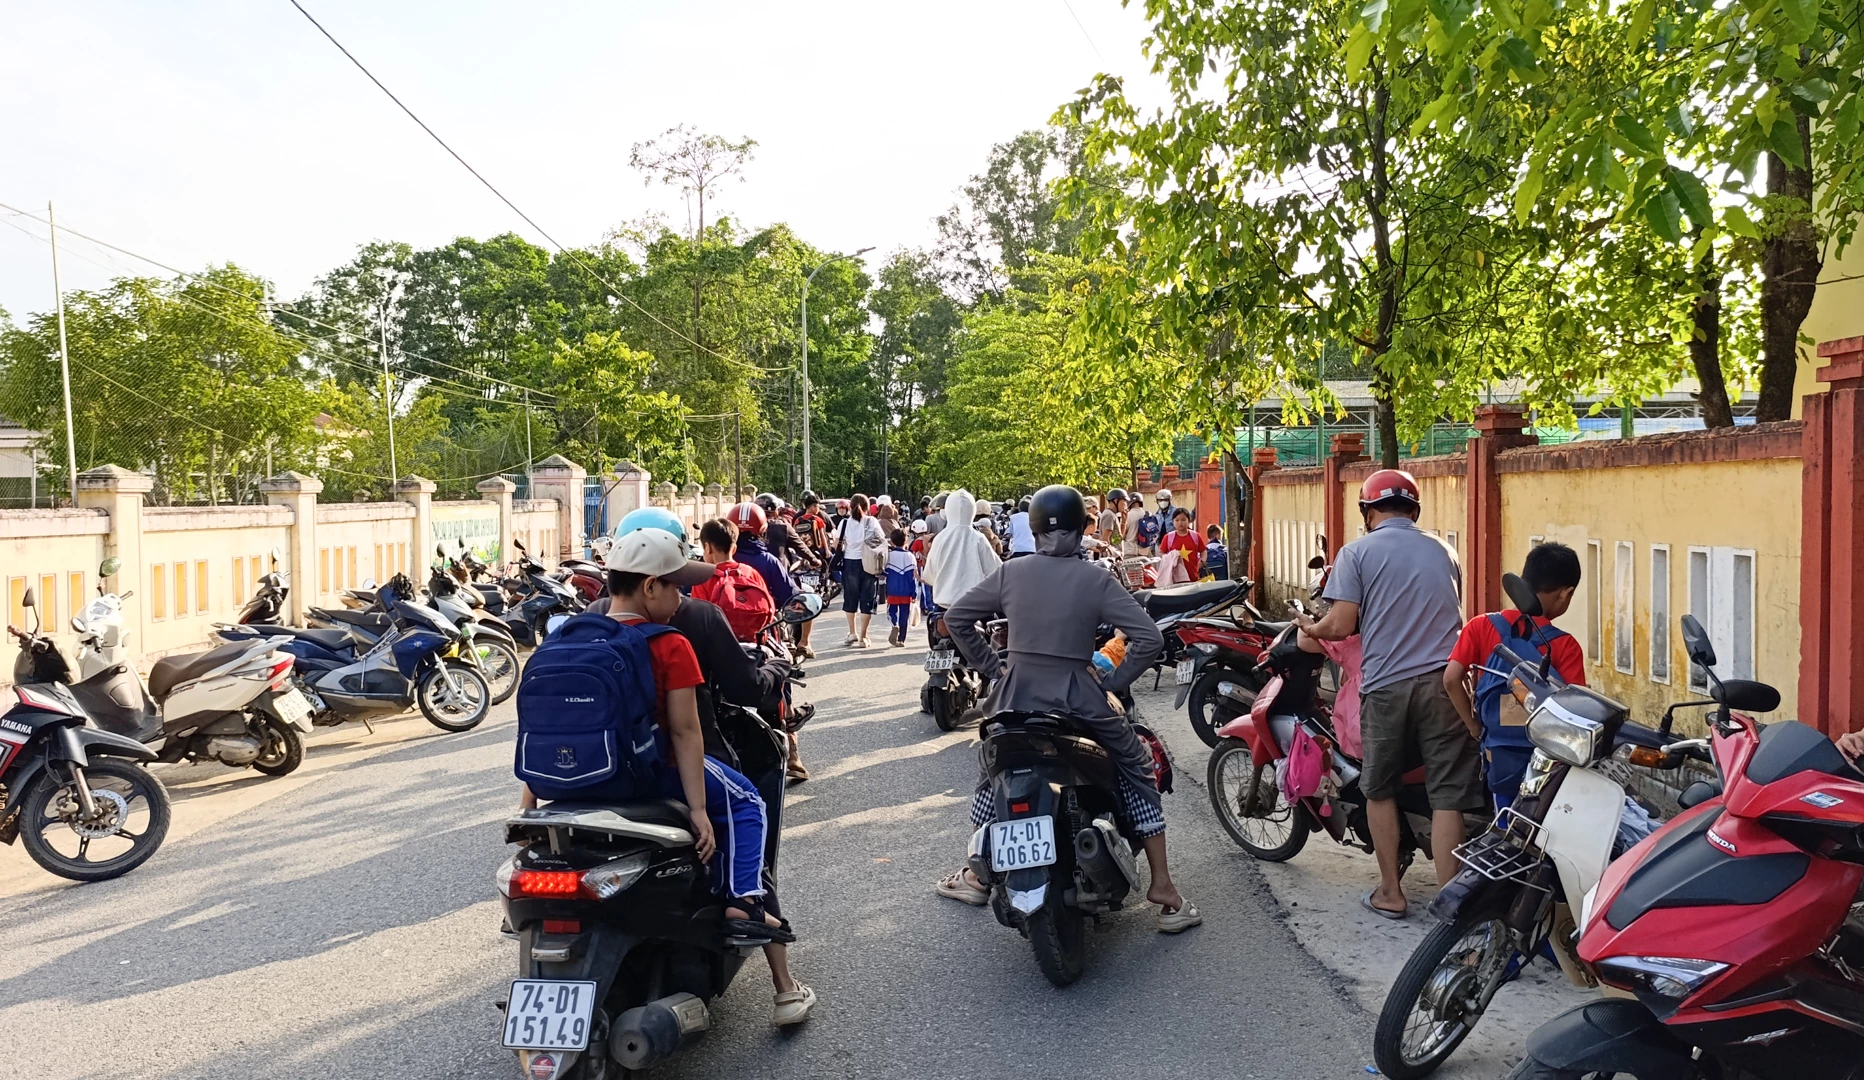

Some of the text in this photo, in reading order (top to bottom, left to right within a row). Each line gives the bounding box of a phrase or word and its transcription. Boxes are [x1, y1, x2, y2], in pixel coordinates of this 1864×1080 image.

[1, 718, 33, 735] YAMAHA
[1000, 821, 1042, 846] 74-D1
[996, 841, 1052, 867] 406.62
[655, 864, 693, 878] LEAD
[520, 985, 580, 1014] 74-D1
[510, 1016, 585, 1046] 151.49
